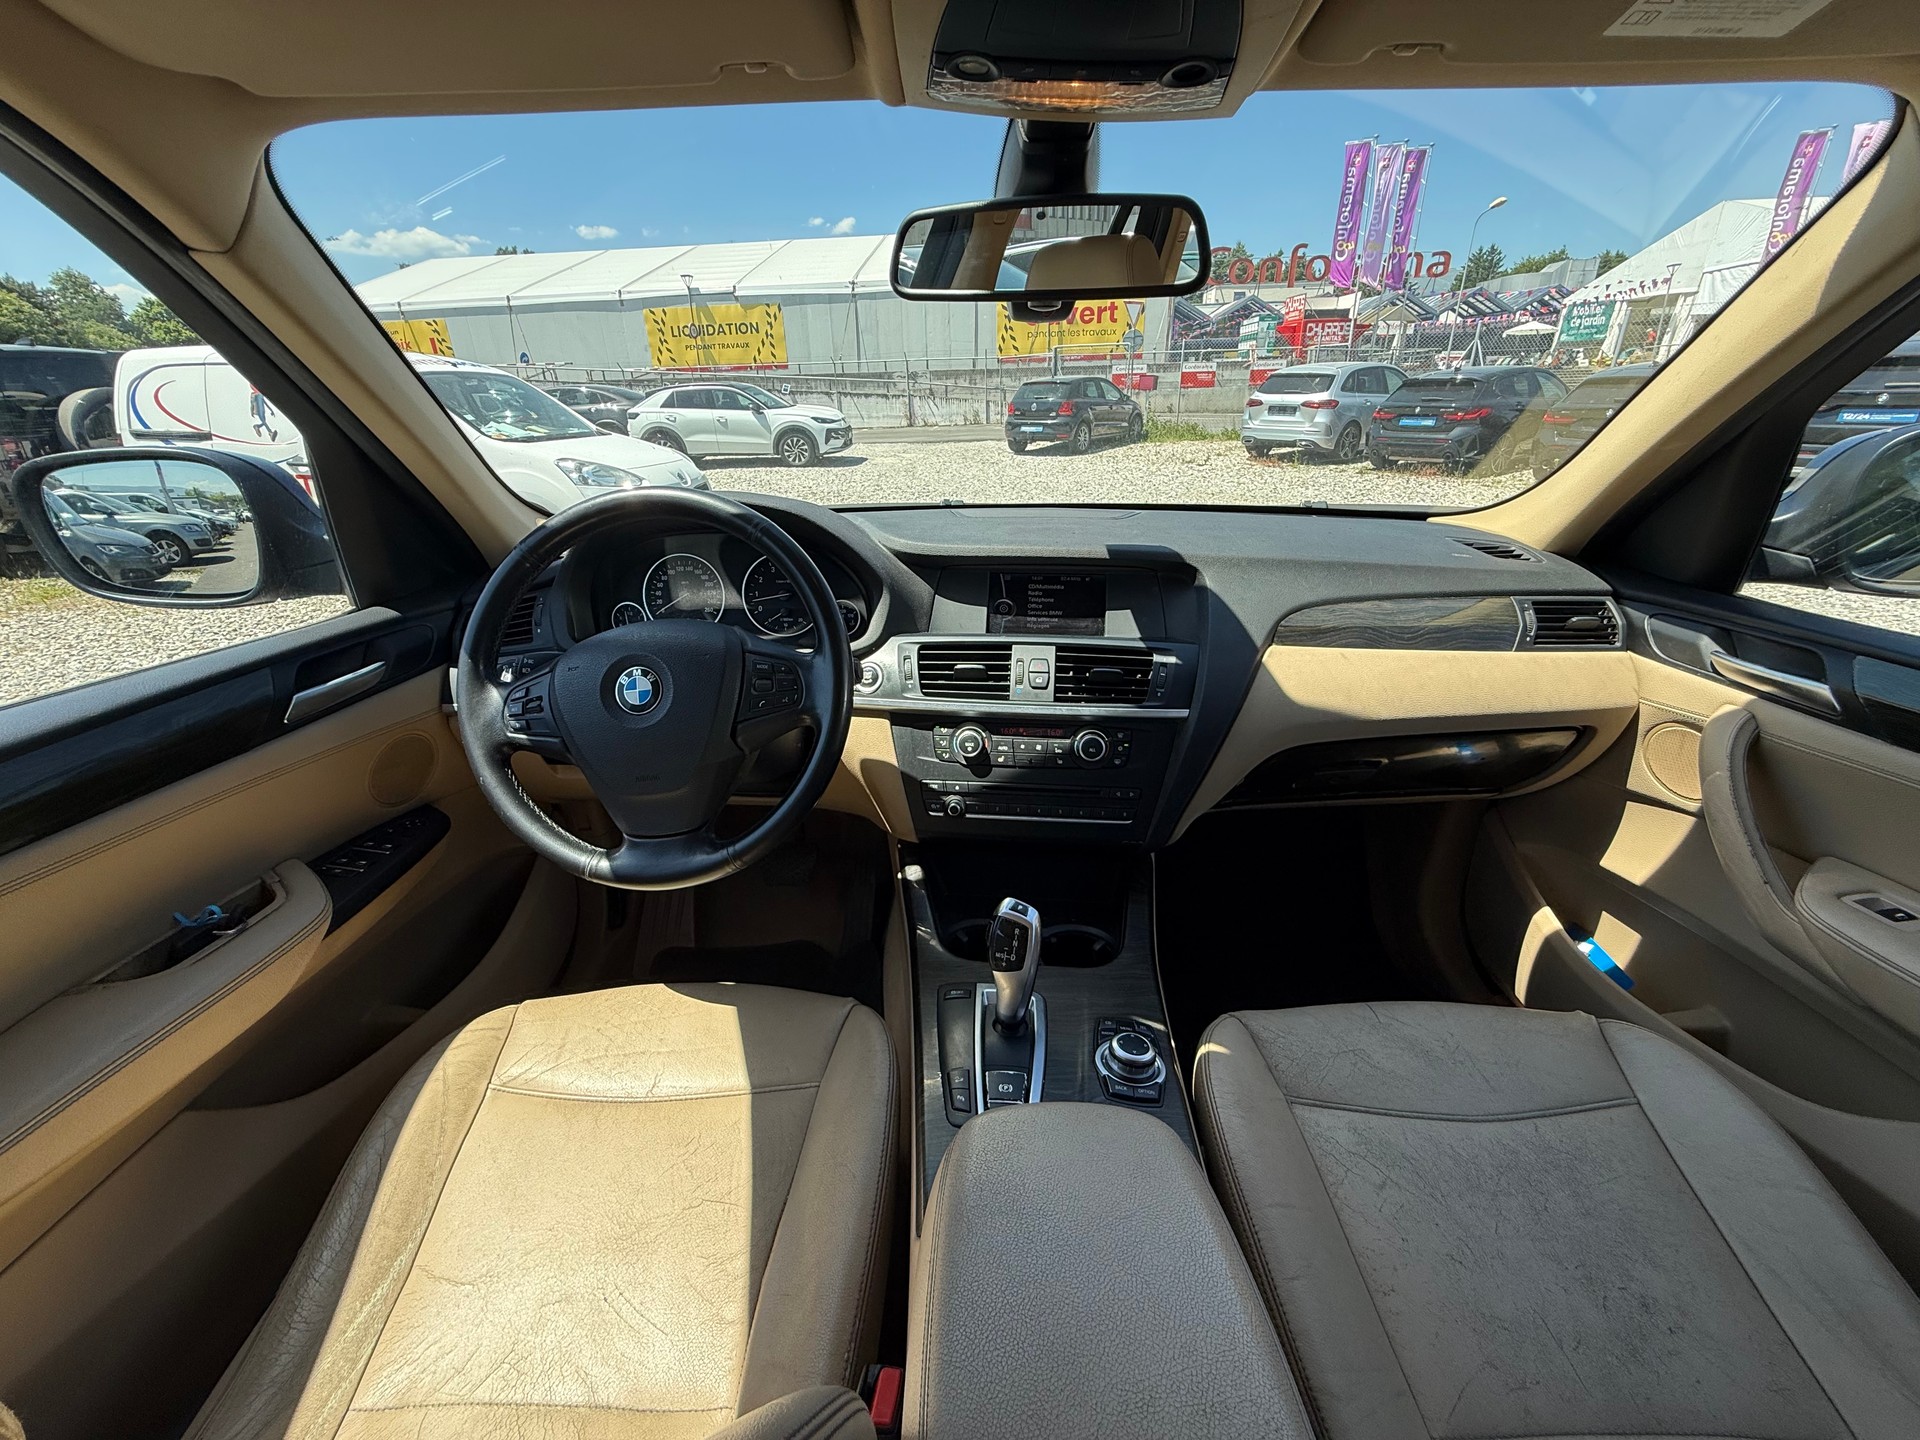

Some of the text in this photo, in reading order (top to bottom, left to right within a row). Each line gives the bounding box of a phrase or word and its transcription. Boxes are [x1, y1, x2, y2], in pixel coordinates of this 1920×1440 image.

[1067, 328, 1081, 338] les
[1082, 327, 1117, 337] travaux
[718, 342, 750, 350] TRAVAUX
[620, 669, 656, 685] BMW
